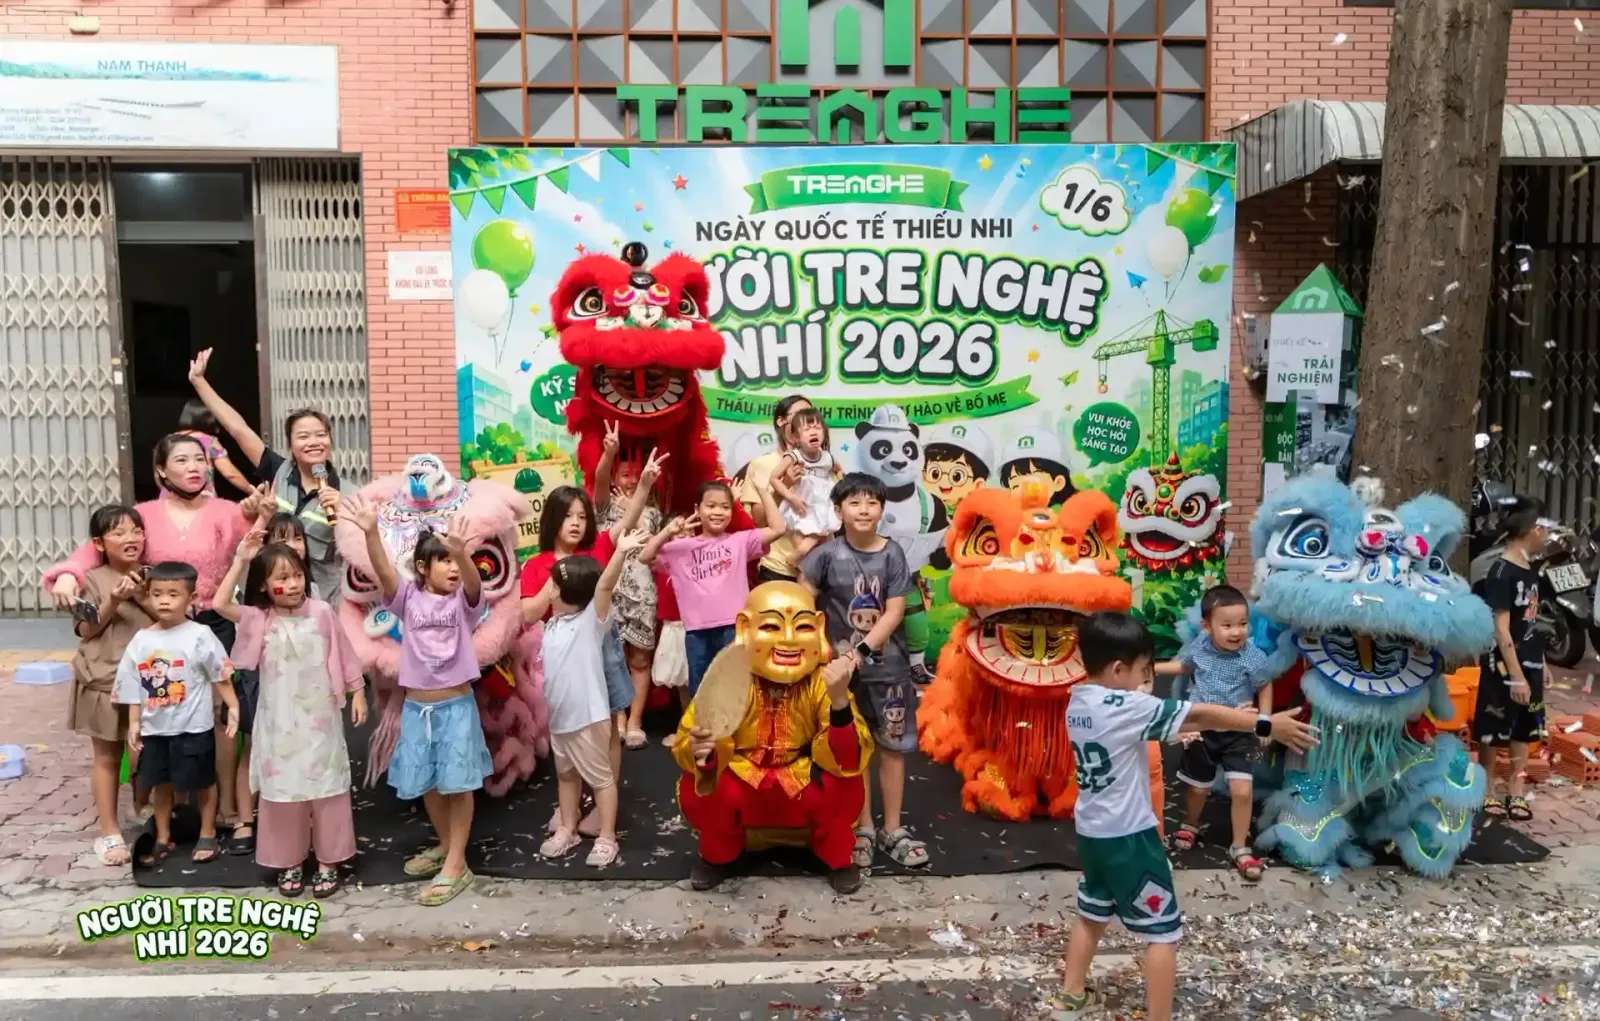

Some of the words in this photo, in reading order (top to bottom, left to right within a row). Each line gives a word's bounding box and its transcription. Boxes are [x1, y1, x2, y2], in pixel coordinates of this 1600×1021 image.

[98, 59, 131, 71] NAM
[137, 59, 187, 72] THANH
[1065, 183, 1113, 222] 1/6
[695, 215, 766, 242] NGÀY
[775, 211, 848, 241] QUỐC
[857, 211, 888, 240] TẾ
[893, 210, 962, 239] THIẾU
[971, 218, 1013, 238] NHI
[804, 252, 922, 306] TRE
[938, 254, 1105, 336] NGHỆ
[720, 309, 826, 382] NHÍ
[843, 320, 994, 374] 2026
[1303, 355, 1334, 369] TRẢI
[540, 375, 563, 397] KỸ
[567, 376, 577, 392] S
[1277, 370, 1333, 387] NGHIỆM
[716, 397, 753, 414] THẤU
[914, 401, 942, 417] HÀO
[945, 396, 963, 413] VỀ
[966, 392, 984, 411] BỐ
[987, 391, 1007, 407] MẸ
[1088, 412, 1104, 424] VUI
[1087, 425, 1108, 438] HỌC
[1277, 430, 1293, 447] ĐỘC
[1081, 436, 1108, 450] SÁNG
[1109, 443, 1127, 455] TẠO
[518, 517, 541, 536] TRÊ
